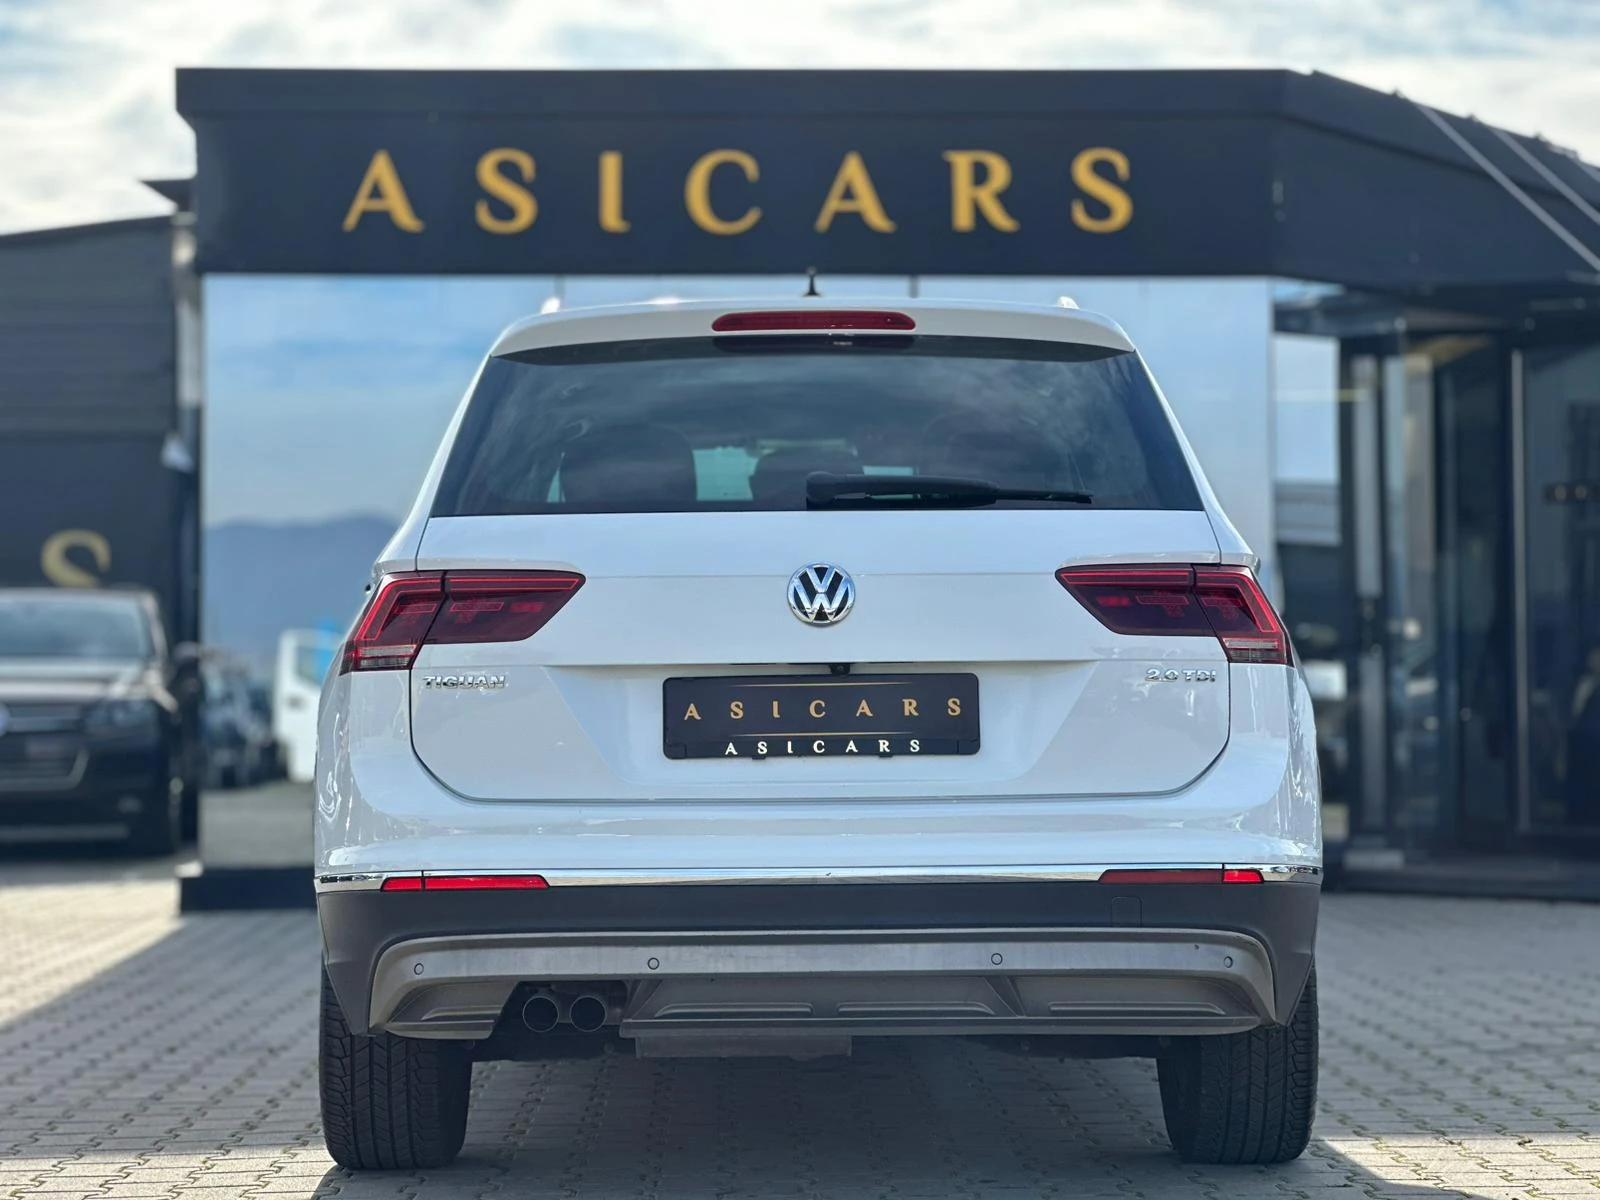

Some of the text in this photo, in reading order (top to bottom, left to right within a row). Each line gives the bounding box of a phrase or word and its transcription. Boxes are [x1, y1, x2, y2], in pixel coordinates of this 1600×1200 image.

[343, 147, 1134, 236] ASICARS
[788, 564, 855, 624] VW
[423, 676, 505, 689] TIGUAN
[1145, 668, 1217, 682] 2.0 TDI
[684, 698, 962, 721] ASICARS
[724, 739, 920, 756] ASICARS
